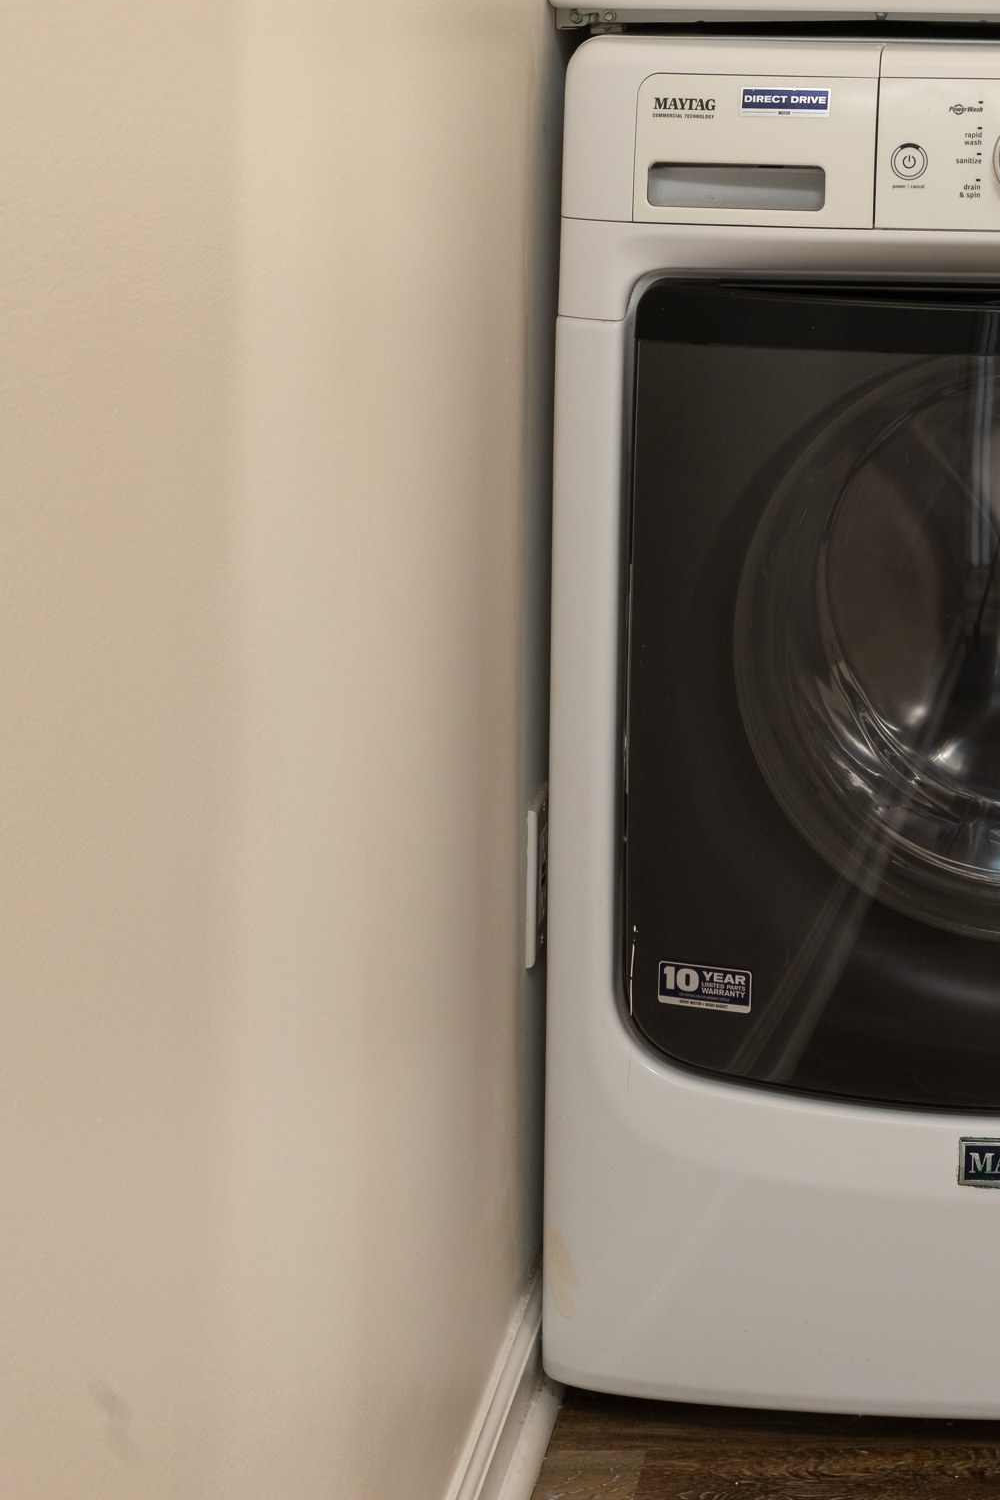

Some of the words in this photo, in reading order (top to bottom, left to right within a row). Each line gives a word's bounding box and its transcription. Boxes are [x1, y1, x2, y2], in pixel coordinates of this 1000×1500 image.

[653, 97, 716, 111] MAYTAG
[744, 95, 788, 103] DIRECT
[790, 96, 826, 104] DRIVE
[965, 132, 982, 140] rapid
[663, 966, 699, 992] 10
[702, 971, 746, 985] YEAR
[701, 987, 746, 998] WARRANTY
[726, 984, 746, 992] PARTS
